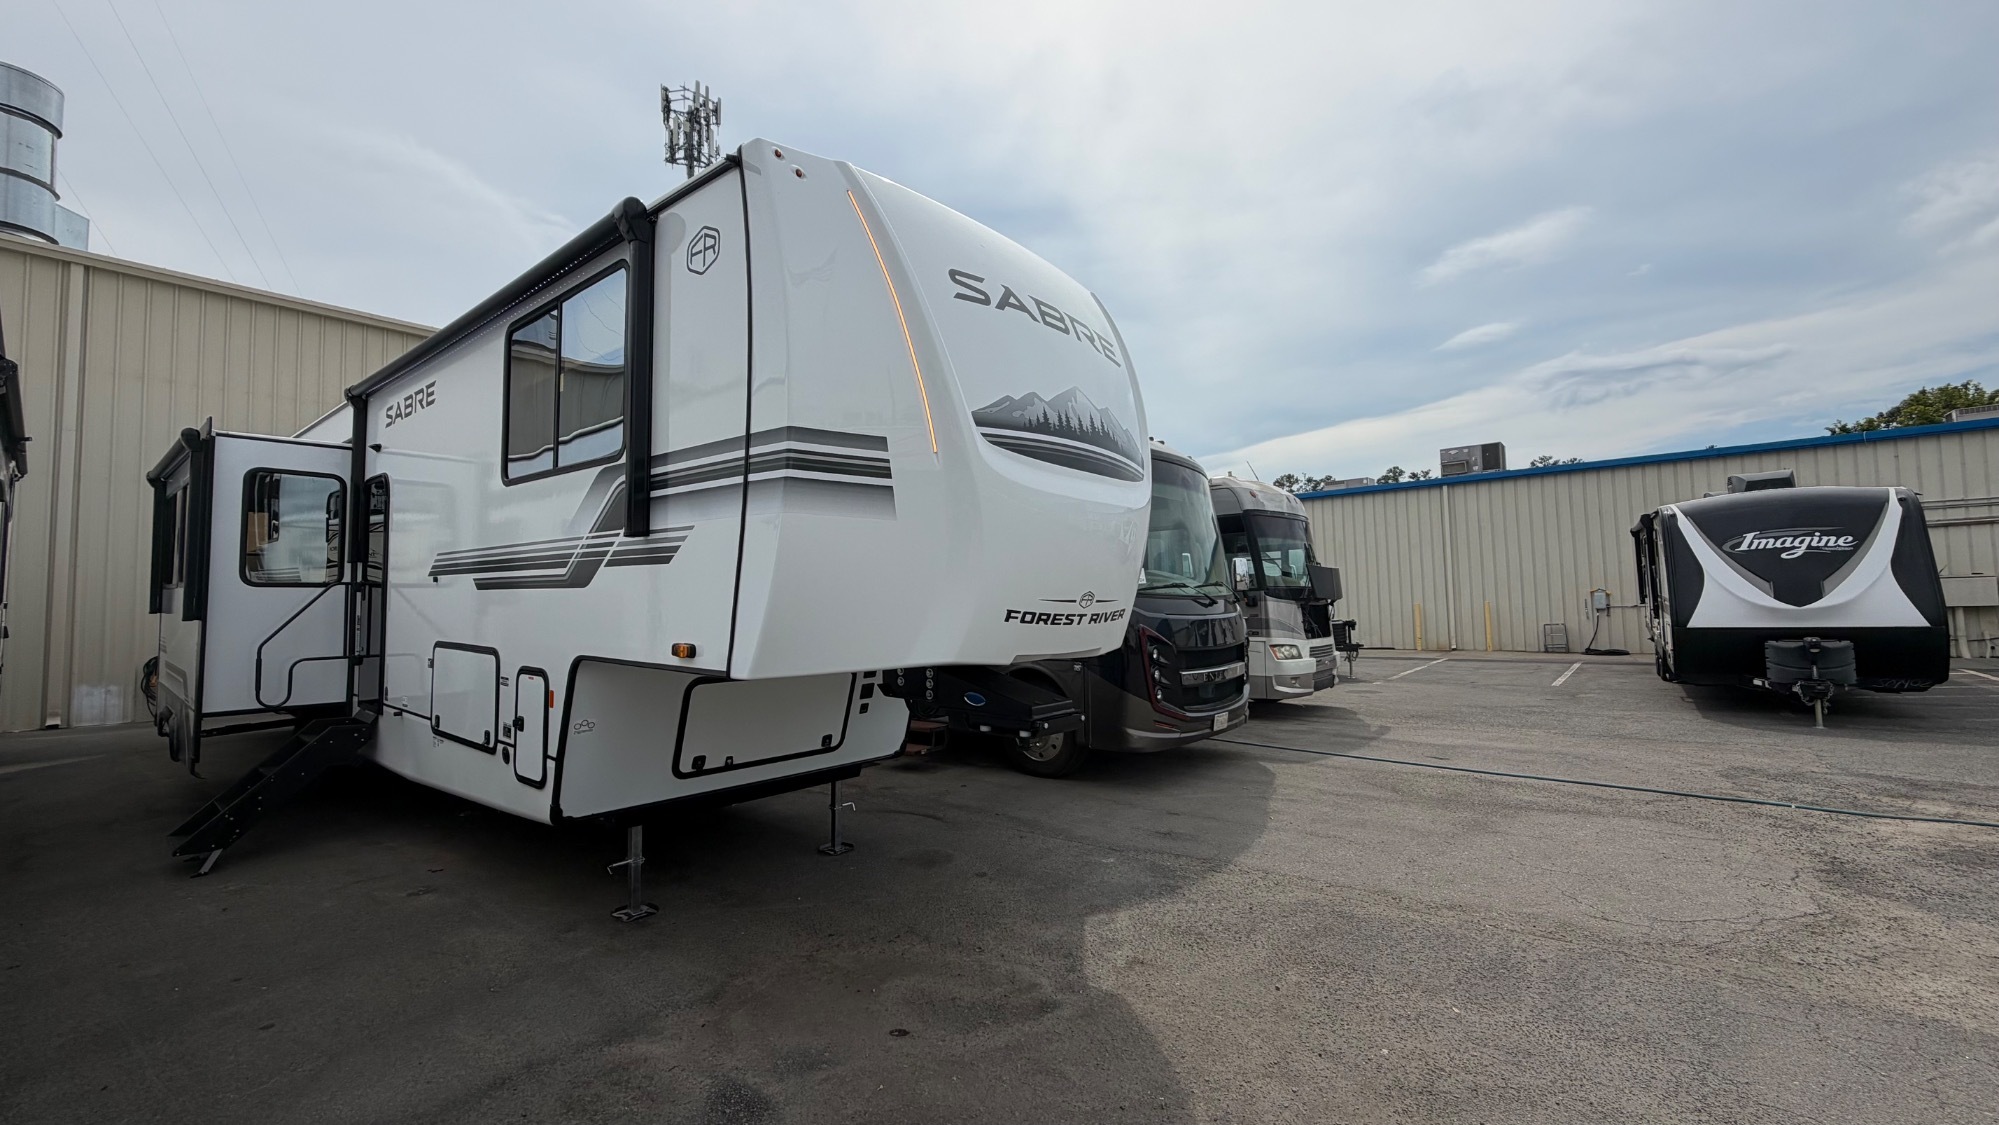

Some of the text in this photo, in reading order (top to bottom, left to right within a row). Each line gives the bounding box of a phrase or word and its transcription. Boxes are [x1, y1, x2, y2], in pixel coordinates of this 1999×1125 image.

[689, 231, 718, 269] FR
[948, 268, 1121, 368] SABRE
[385, 380, 437, 428] SABRE
[1735, 532, 1859, 559] Imagine
[1004, 608, 1126, 625] FOREST RIVER
